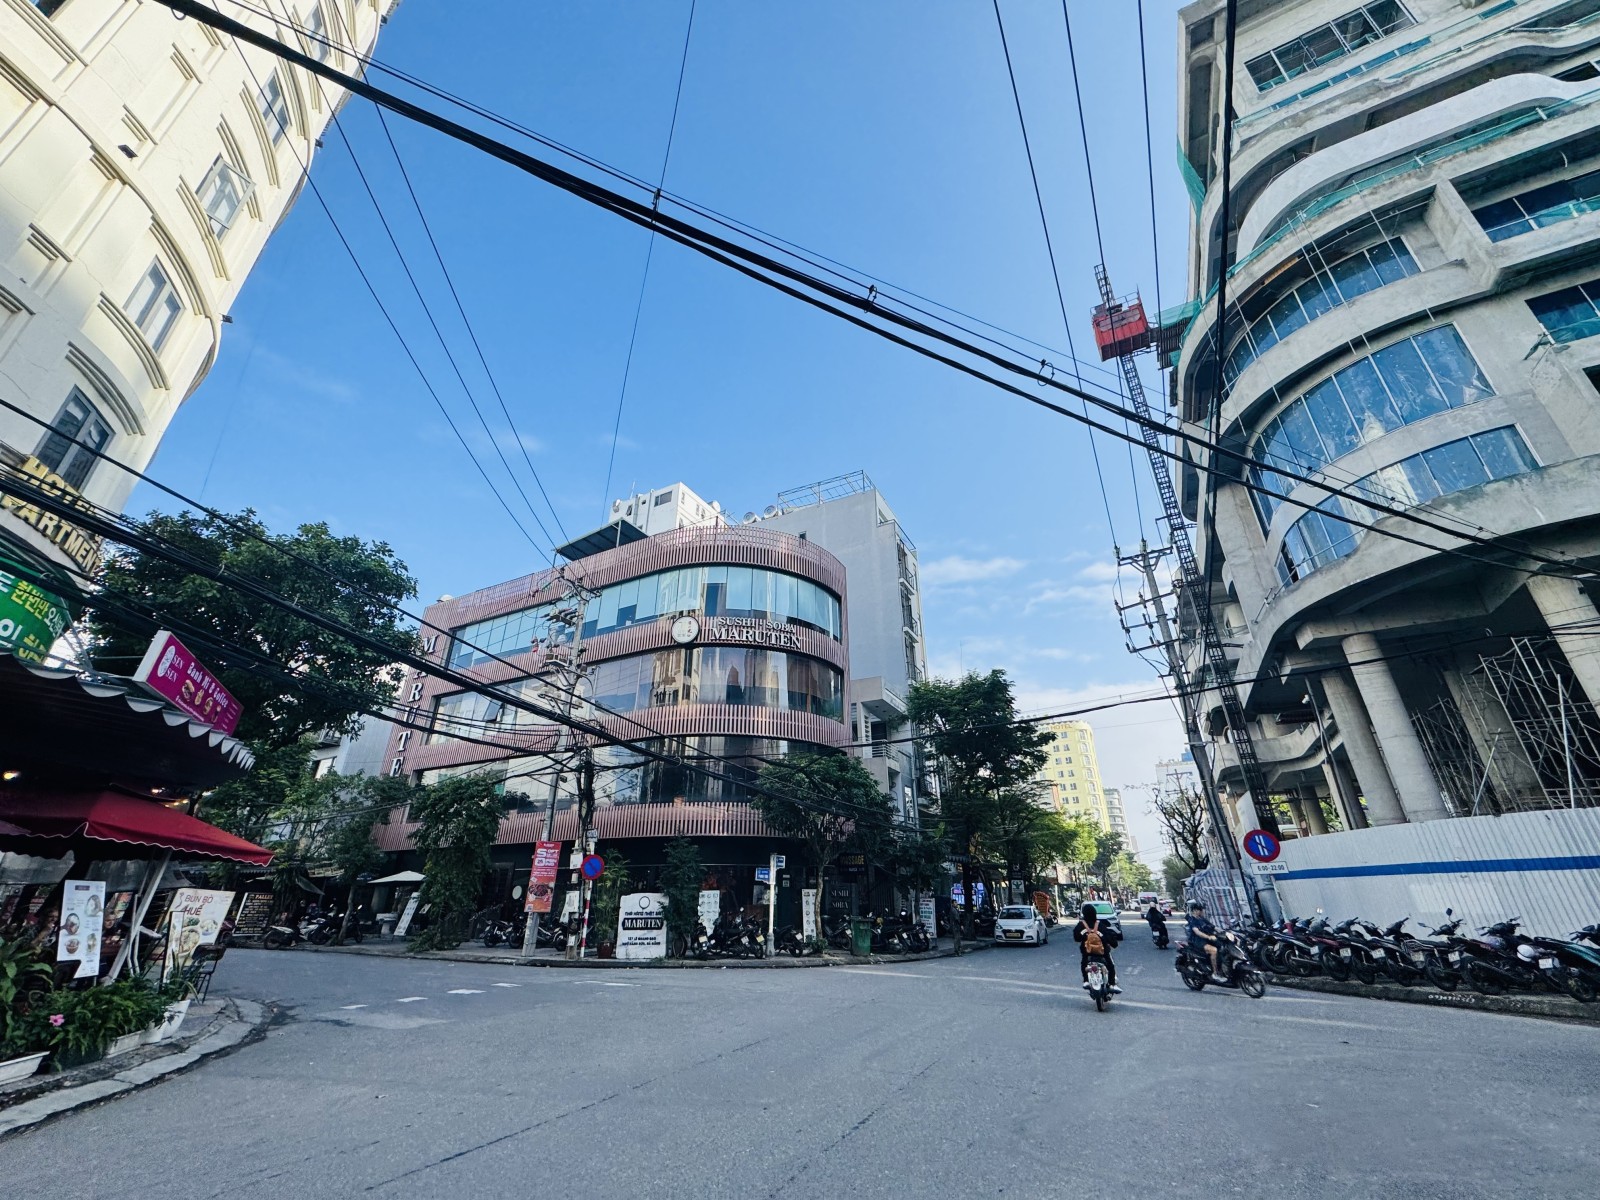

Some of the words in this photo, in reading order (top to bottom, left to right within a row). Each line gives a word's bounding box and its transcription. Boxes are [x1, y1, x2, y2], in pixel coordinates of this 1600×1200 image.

[719, 616, 756, 627] SUSHI
[765, 620, 796, 633] SOBA
[710, 627, 803, 648] MARUTEN
[624, 919, 661, 928] MARUTEN
